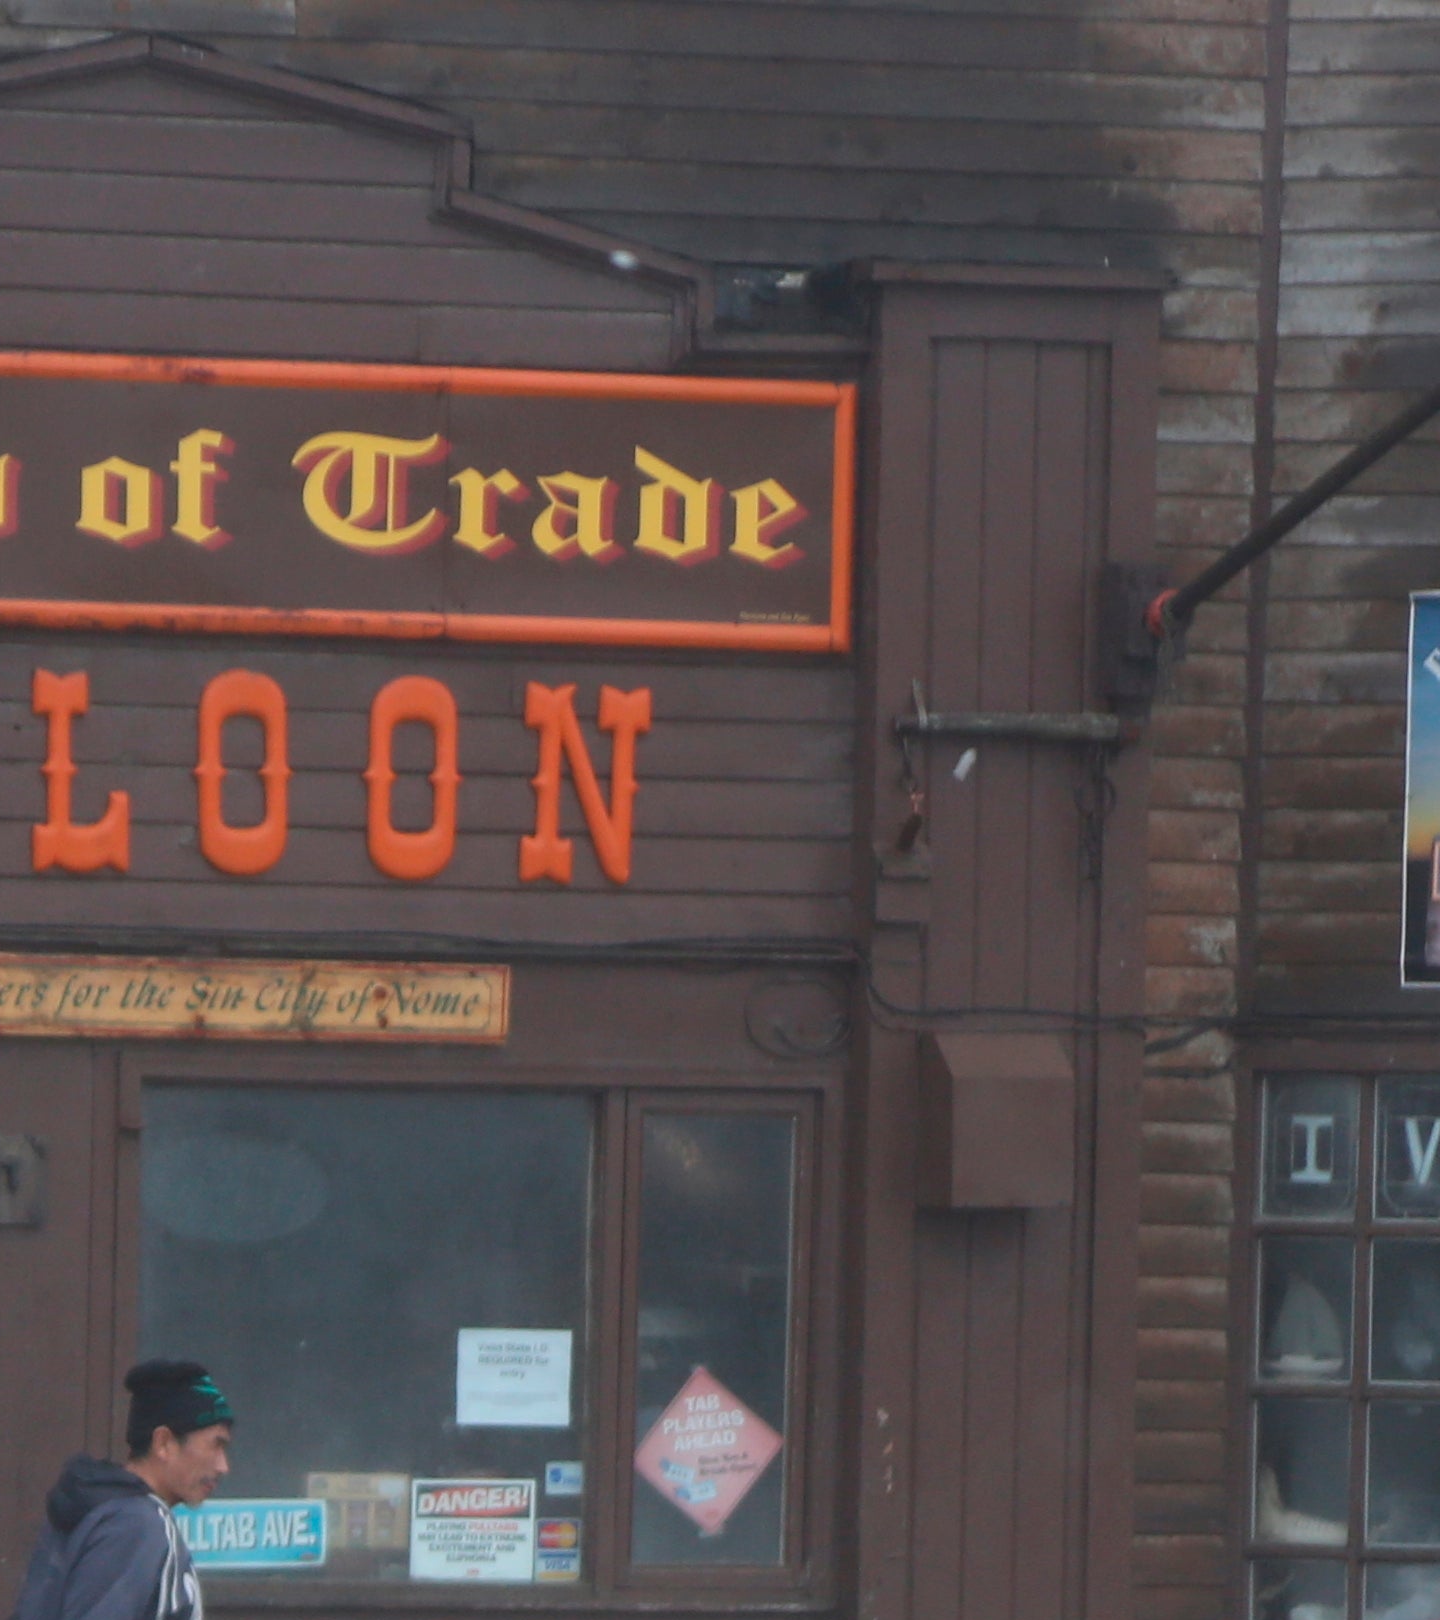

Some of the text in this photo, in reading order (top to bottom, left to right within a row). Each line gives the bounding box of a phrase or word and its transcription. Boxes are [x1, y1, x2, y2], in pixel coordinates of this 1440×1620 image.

[76, 427, 236, 550] of
[291, 430, 808, 570] Trade
[52, 974, 110, 1021] for
[120, 973, 174, 1010] the
[186, 974, 245, 1012] Sin
[254, 977, 328, 1019] City
[336, 979, 374, 1023] of
[376, 980, 480, 1019] Nome
[685, 1393, 720, 1412] TAB
[663, 1408, 745, 1436] PLAYERS
[673, 1429, 737, 1453] AHEAD
[418, 1484, 529, 1514] DANGER!
[176, 1508, 316, 1550] LLTAB AVE.
[545, 1559, 570, 1570] VISA
